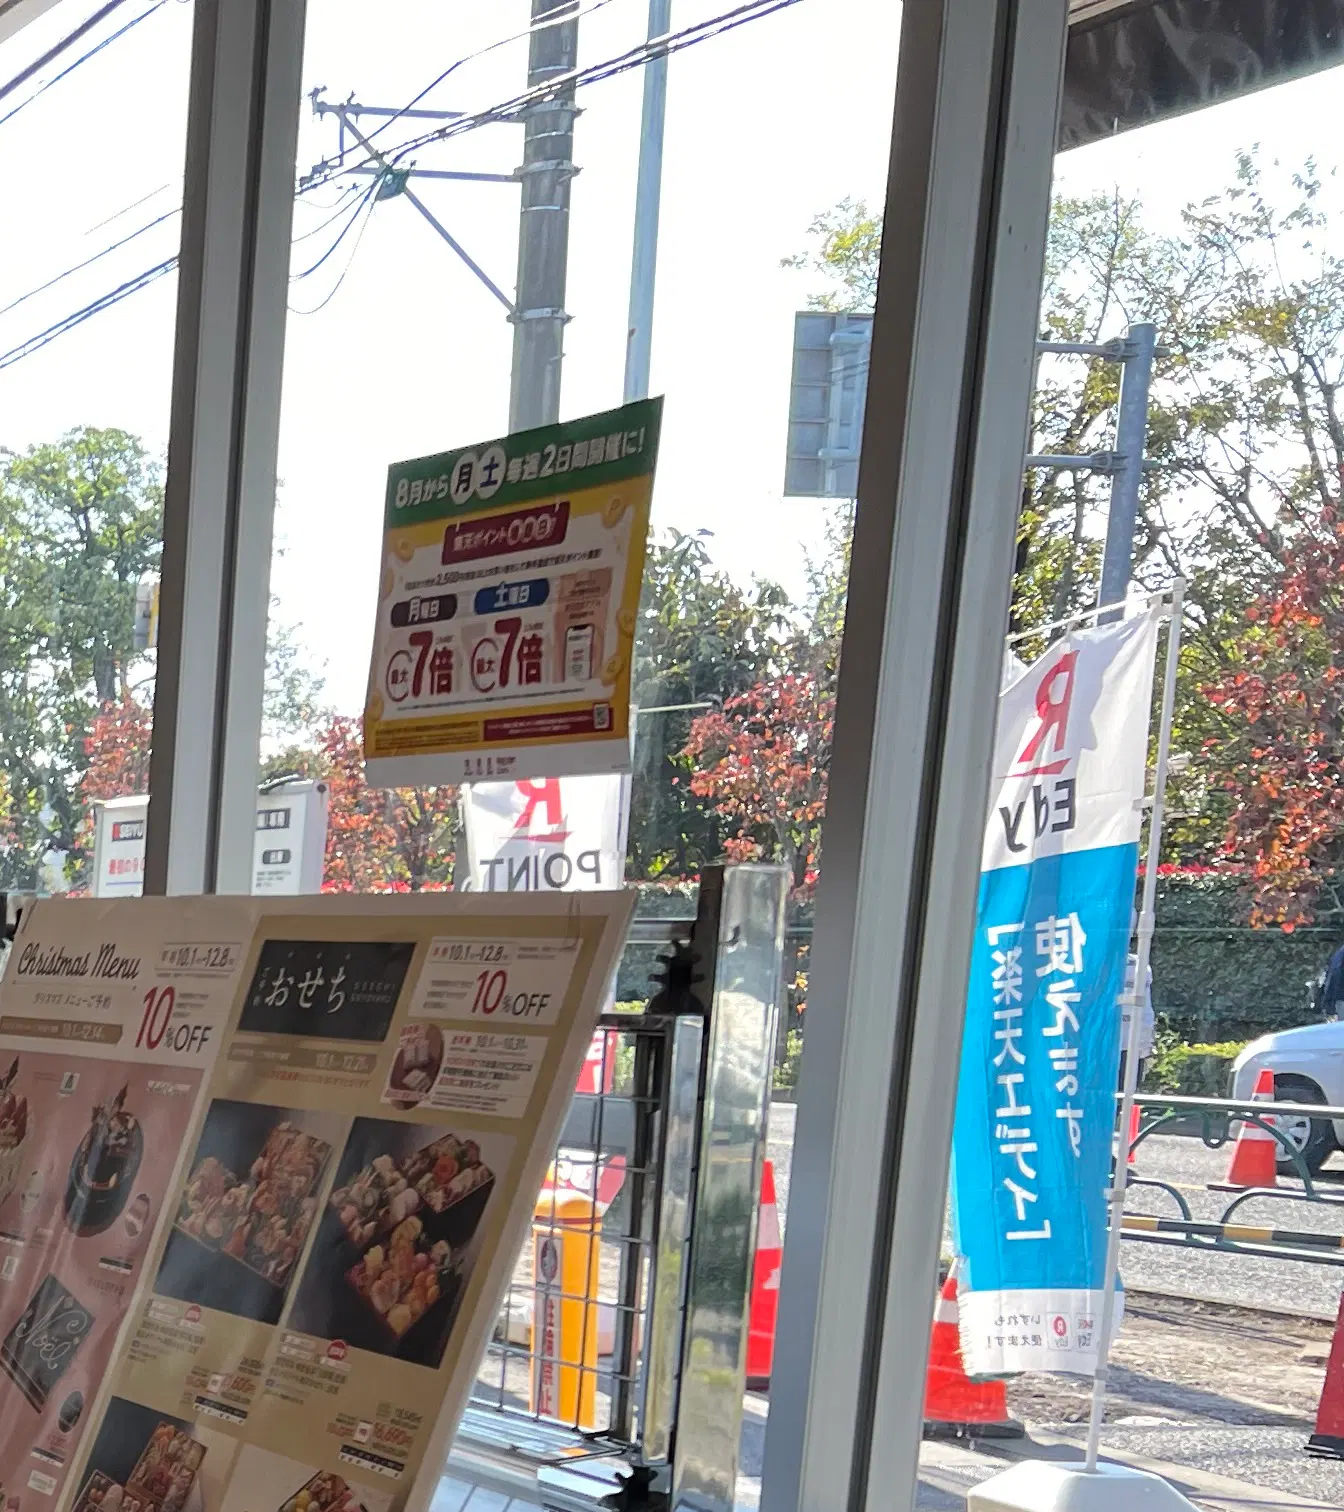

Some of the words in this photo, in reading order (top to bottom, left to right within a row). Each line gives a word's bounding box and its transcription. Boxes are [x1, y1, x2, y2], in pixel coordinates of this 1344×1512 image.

[16, 942, 90, 977] Christmas
[90, 943, 142, 979] Menu
[265, 965, 348, 1014] おせち
